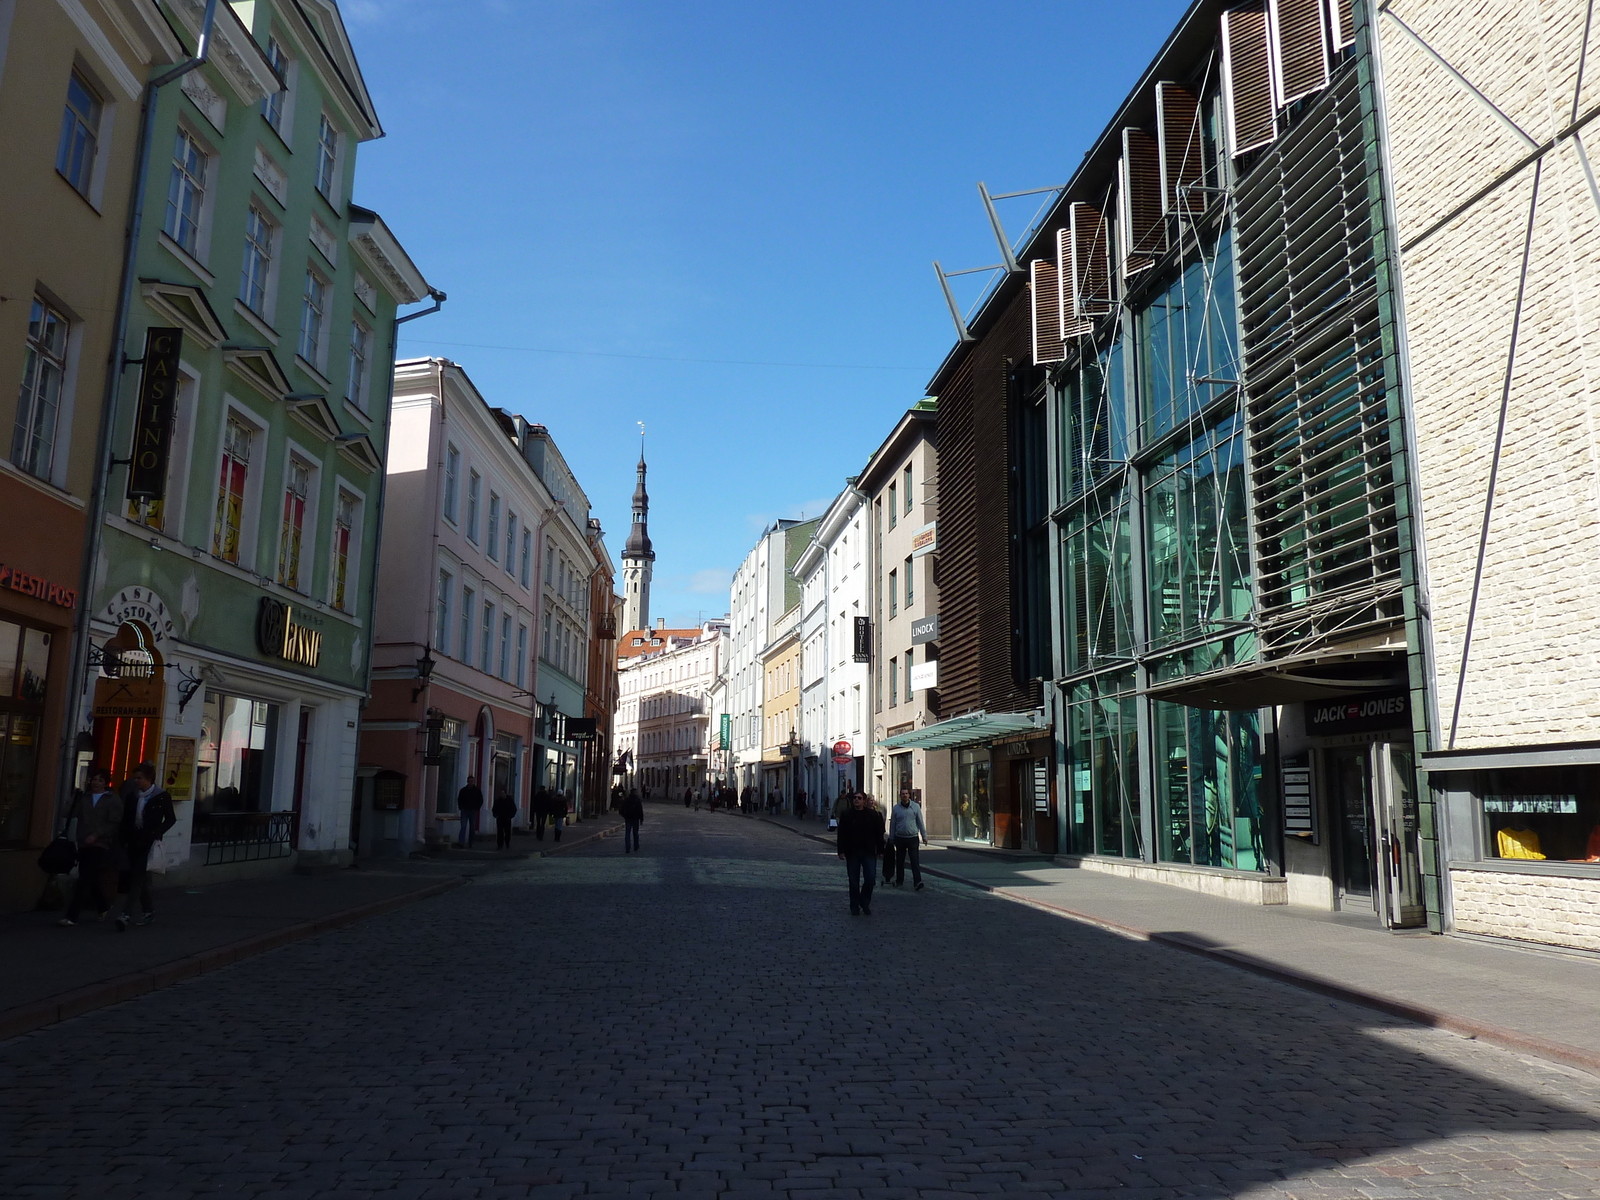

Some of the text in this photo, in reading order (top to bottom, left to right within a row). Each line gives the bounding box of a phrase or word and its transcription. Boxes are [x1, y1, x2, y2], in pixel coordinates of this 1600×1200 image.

[139, 336, 172, 469] CASINO
[10, 568, 79, 609] EESTI POST
[107, 588, 173, 632] CASINO
[111, 606, 163, 642] ESTORAN
[912, 622, 935, 638] LINDEX
[95, 706, 158, 716] RESTORAN-BAAR
[1313, 696, 1406, 724] JACK JONES
[1007, 741, 1030, 756] LINDEX
